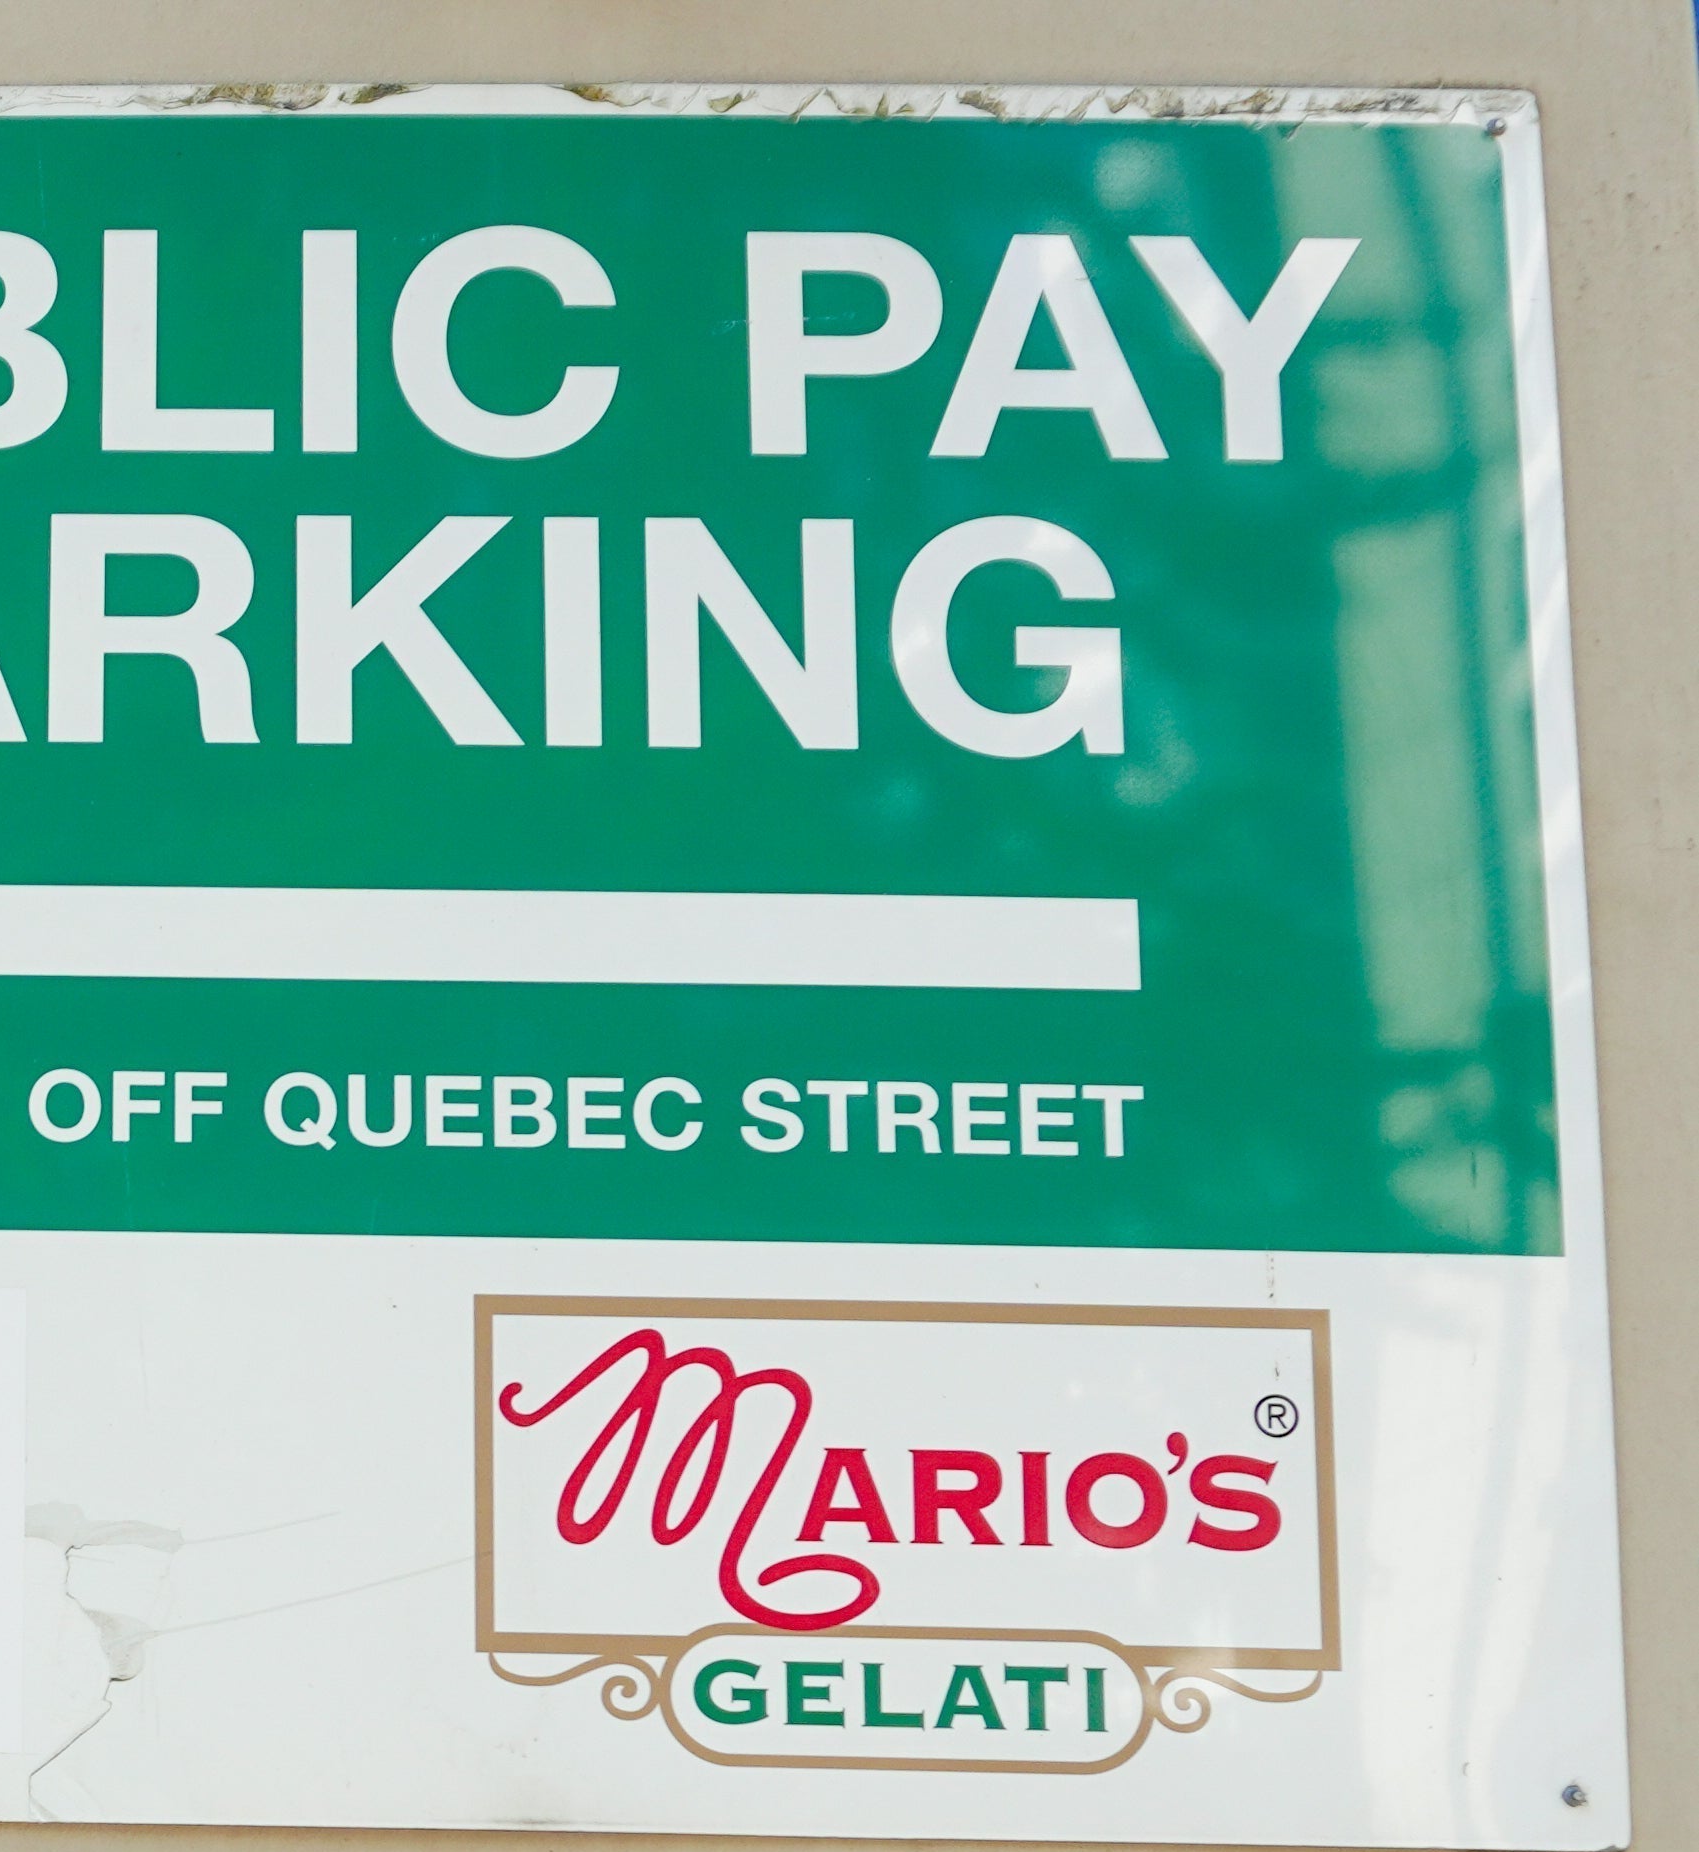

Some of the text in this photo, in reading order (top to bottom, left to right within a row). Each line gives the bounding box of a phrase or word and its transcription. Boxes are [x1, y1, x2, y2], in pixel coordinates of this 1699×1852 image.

[747, 232, 1363, 460] PAY
[29, 1069, 227, 1142] OFF
[264, 1072, 702, 1150] QUEBEC
[741, 1079, 1143, 1156] STREET
[694, 1660, 1105, 1731] GELATI
